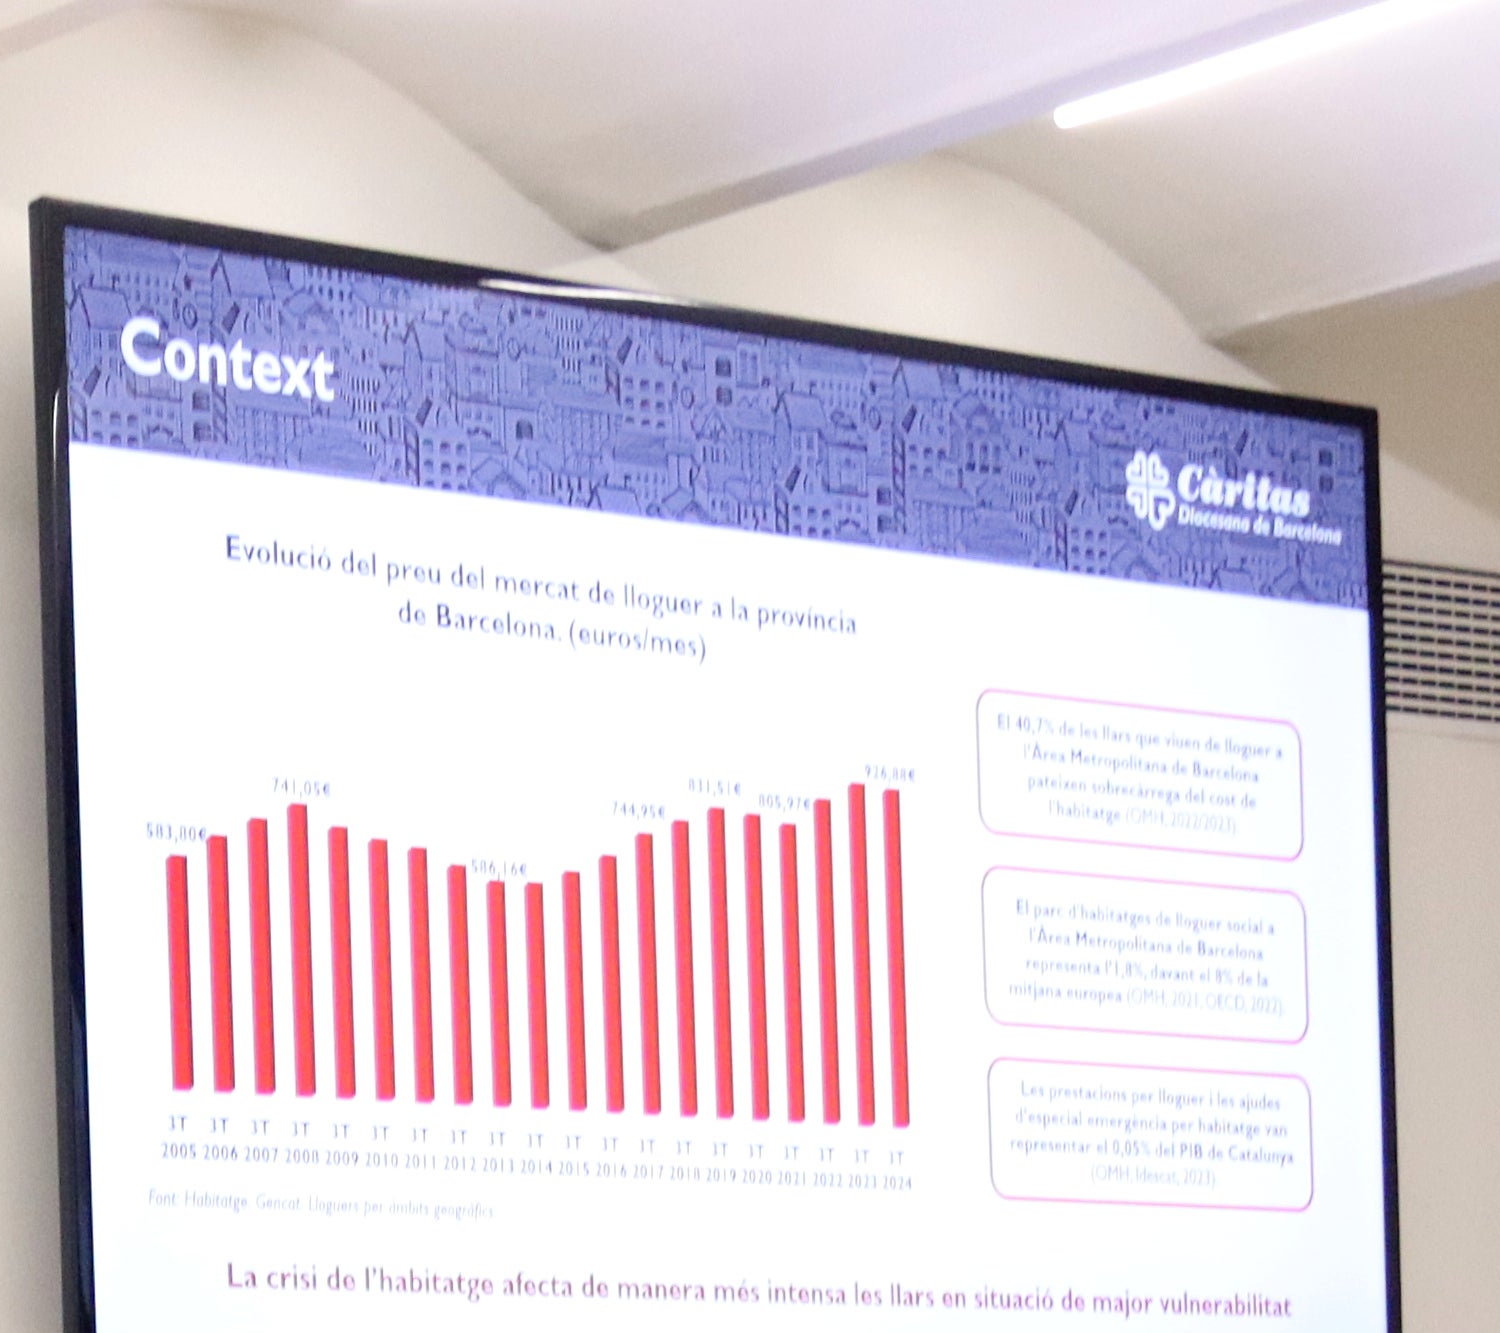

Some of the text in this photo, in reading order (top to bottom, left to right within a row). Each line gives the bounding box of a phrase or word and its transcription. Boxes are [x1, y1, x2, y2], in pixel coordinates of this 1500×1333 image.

[120, 316, 335, 402] Context
[1177, 463, 1311, 518] Càritas
[1178, 503, 1342, 546] Diocesana de Barcelona
[226, 534, 857, 635] Evolució del preu del mercat de lloguer a la província
[399, 599, 706, 665] de Barcelona. (euros/mes)
[997, 713, 1011, 731] El
[1059, 721, 1075, 737] de
[1080, 722, 1098, 740] les
[1102, 725, 1131, 744] llars
[1136, 732, 1160, 749] que
[1164, 732, 1200, 751] viuen
[1204, 735, 1220, 752] de
[1225, 736, 1271, 760] lloguer
[1070, 748, 1168, 775] Metropolitana
[1171, 756, 1188, 777] de
[1192, 757, 1259, 784] Barcelona
[1028, 774, 1256, 810] pateixen sobrecàrrega del cost de
[1016, 898, 1029, 916] El
[1033, 904, 1062, 922] parc
[1156, 909, 1171, 928] de
[1175, 913, 1222, 934] lloguer
[1227, 917, 1263, 935] social
[1076, 930, 1172, 955] Metropolitana
[1176, 939, 1192, 956] de
[1197, 940, 1264, 962] Barcelona
[1026, 958, 1100, 976] representa
[1151, 963, 1194, 983] davant
[1199, 966, 1210, 983] el
[1215, 968, 1233, 985] 8%
[1237, 969, 1253, 987] de
[1257, 969, 1269, 988] la
[1009, 982, 1122, 1006] mitjana europea
[1020, 1080, 1044, 1097] Les
[1050, 1085, 1127, 1103] prestacions
[1132, 1090, 1154, 1107] per
[1158, 1088, 1205, 1109] lloguer
[1217, 1091, 1235, 1109] les
[1240, 1092, 1281, 1113] ajudes
[1087, 1115, 1167, 1134] emergència
[1171, 1119, 1194, 1135] per
[1198, 1117, 1261, 1141] habitatge
[1264, 1125, 1288, 1137] van
[161, 1142, 911, 1190] 2005 2006 2007 2008 2009 2010 2011 2012 2013 2014 2015 2016 2017 2018 2019 2020 2021 2022 2023 2024
[1010, 1137, 1091, 1155] representar
[1096, 1138, 1108, 1154] el
[1155, 1141, 1176, 1158] del
[1180, 1142, 1203, 1159] PIB
[1208, 1143, 1224, 1161] de
[1228, 1144, 1294, 1168] Catalunya
[227, 1262, 257, 1289] La
[267, 1265, 317, 1291] crisi
[327, 1266, 355, 1292] de
[502, 1271, 572, 1298] afecta
[582, 1273, 608, 1299] de
[618, 1281, 705, 1302] manera
[714, 1279, 759, 1303] més
[768, 1279, 846, 1306] intensa
[855, 1281, 882, 1308] les
[891, 1283, 934, 1309] llars
[942, 1291, 966, 1308] en
[974, 1286, 1053, 1312] situació
[1062, 1289, 1085, 1312] de
[1093, 1289, 1152, 1320] major
[1160, 1291, 1292, 1318] vulnerabilitat
